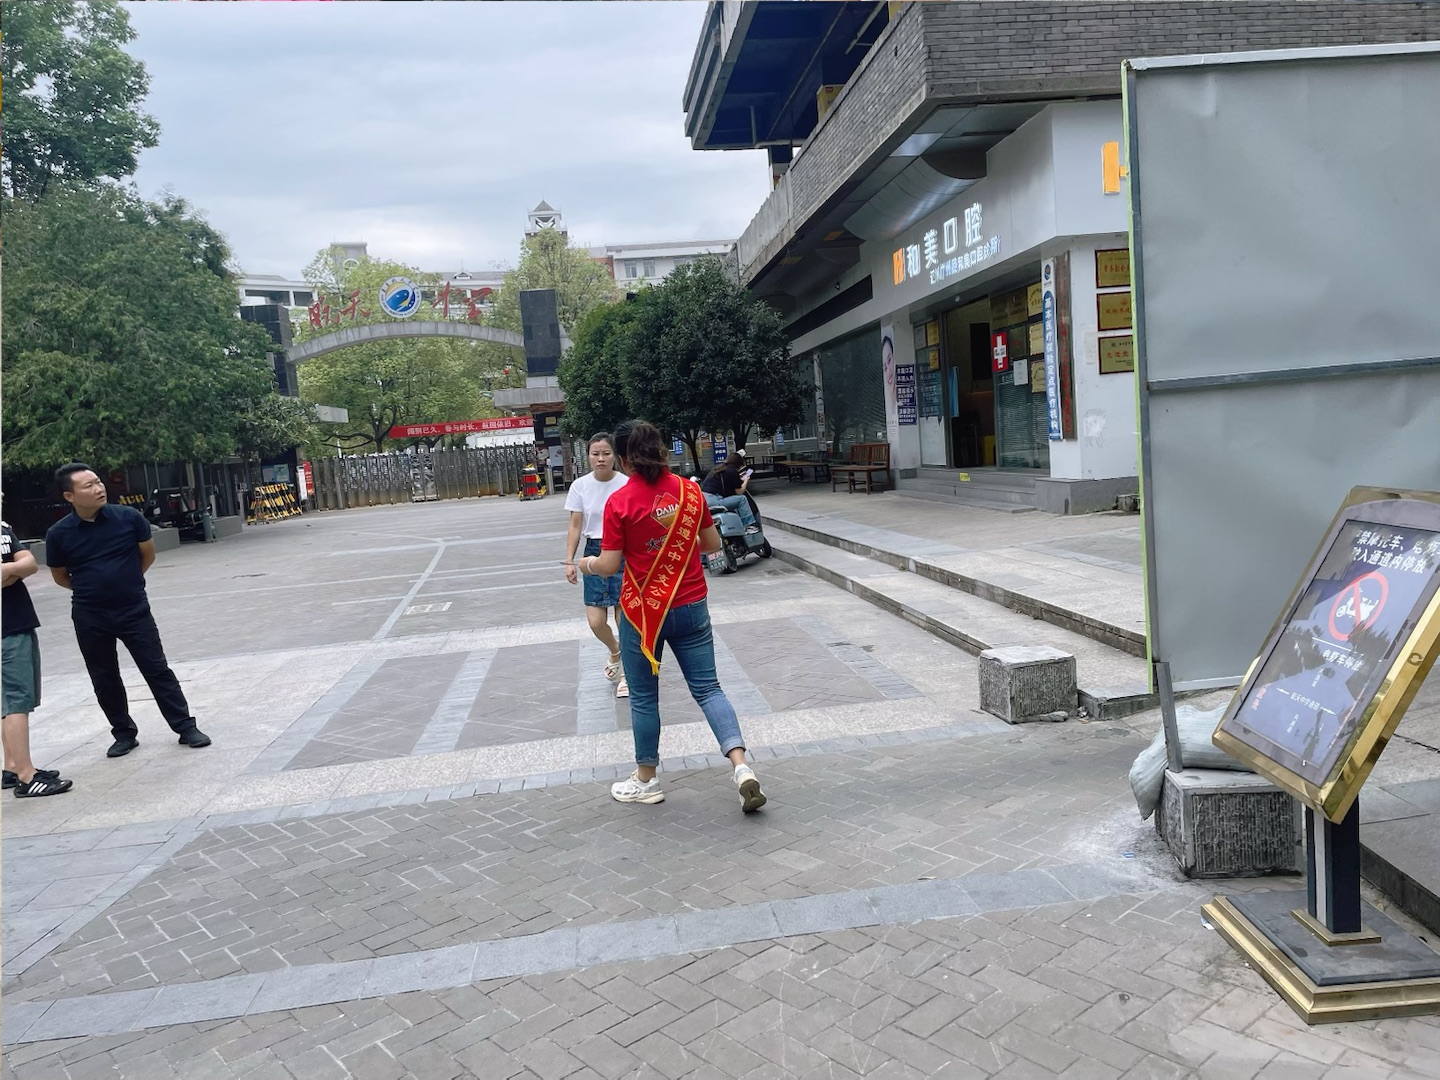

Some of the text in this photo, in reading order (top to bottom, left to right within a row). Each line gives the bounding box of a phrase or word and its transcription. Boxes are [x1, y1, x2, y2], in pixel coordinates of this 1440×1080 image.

[905, 201, 984, 279] 和美口腔
[645, 482, 699, 611] 大家财险遵义中心支公司
